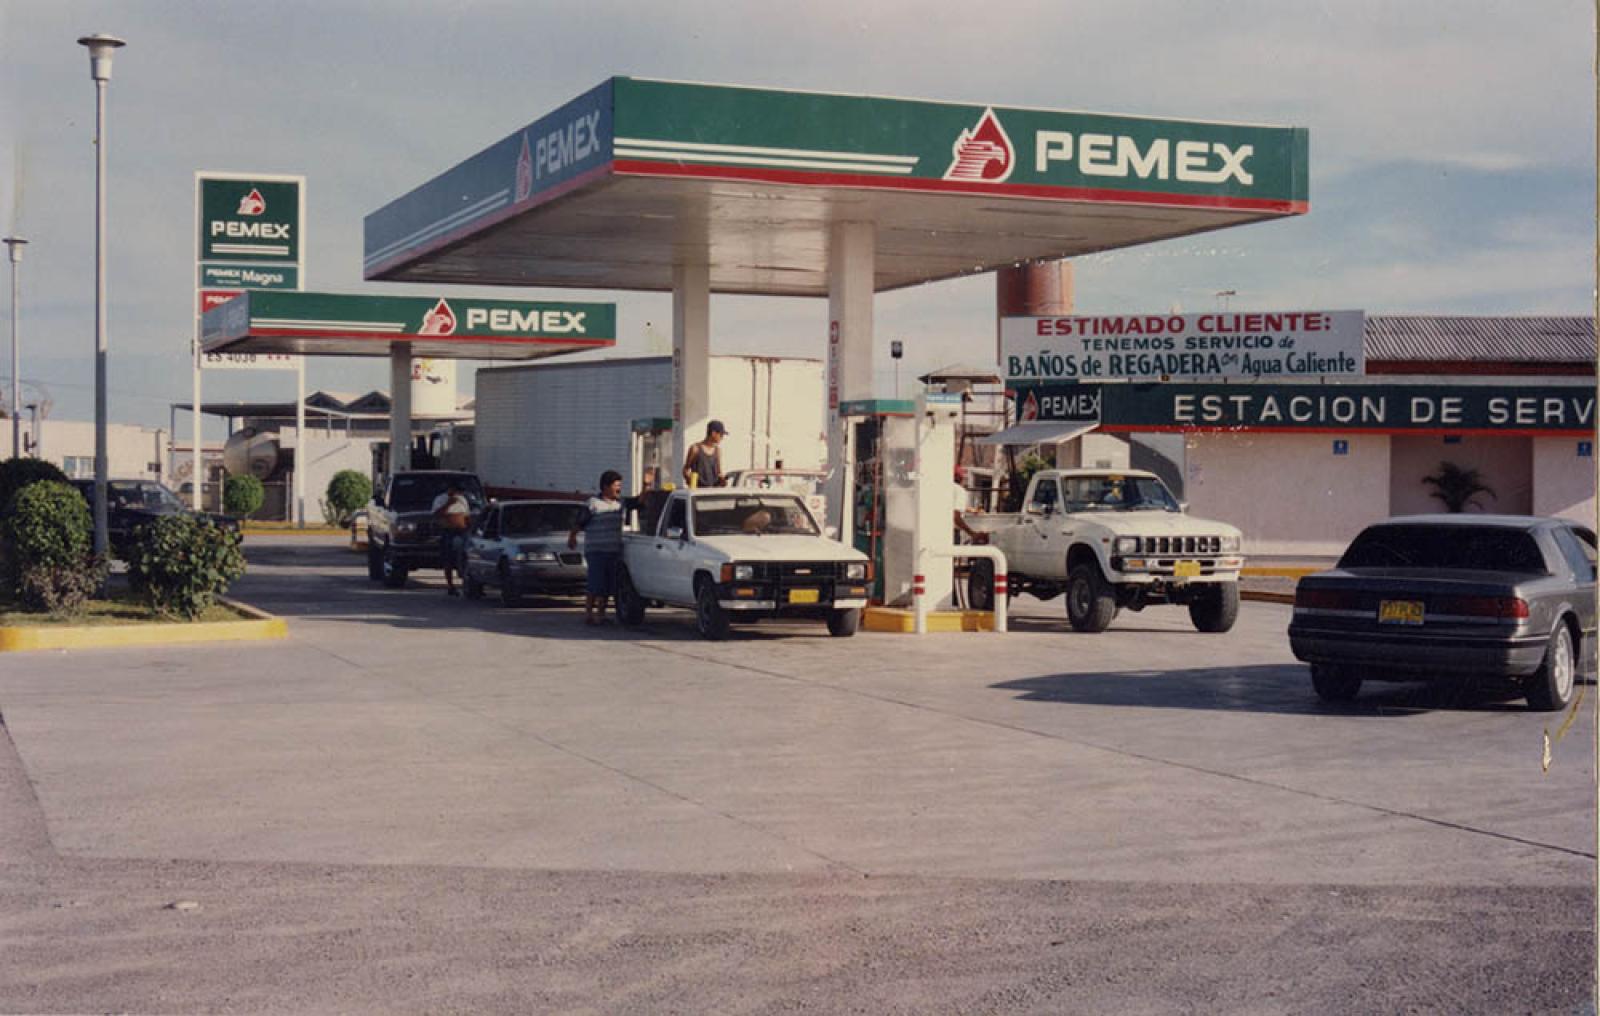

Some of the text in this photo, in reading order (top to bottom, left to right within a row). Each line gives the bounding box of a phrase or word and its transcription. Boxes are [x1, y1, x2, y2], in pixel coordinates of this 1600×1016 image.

[535, 110, 600, 179] PEMEX
[1036, 130, 1254, 185] PEMEX
[211, 220, 290, 239] PEMEX
[206, 268, 284, 286] PEMEX Magna
[466, 308, 587, 334] PEMEX
[1037, 312, 1331, 336] ESTIMADO CLIENTE:
[1080, 335, 1295, 351] TENEMOS SERVICIO de
[1008, 350, 1078, 377] BAÑOS
[1081, 355, 1102, 376] de
[1109, 352, 1221, 376] REGADERA
[1241, 352, 1282, 377] Agua
[1285, 350, 1356, 373] Caliente
[1041, 393, 1101, 417] PEMEX
[1174, 394, 1595, 426] ESTACION DE SERV
